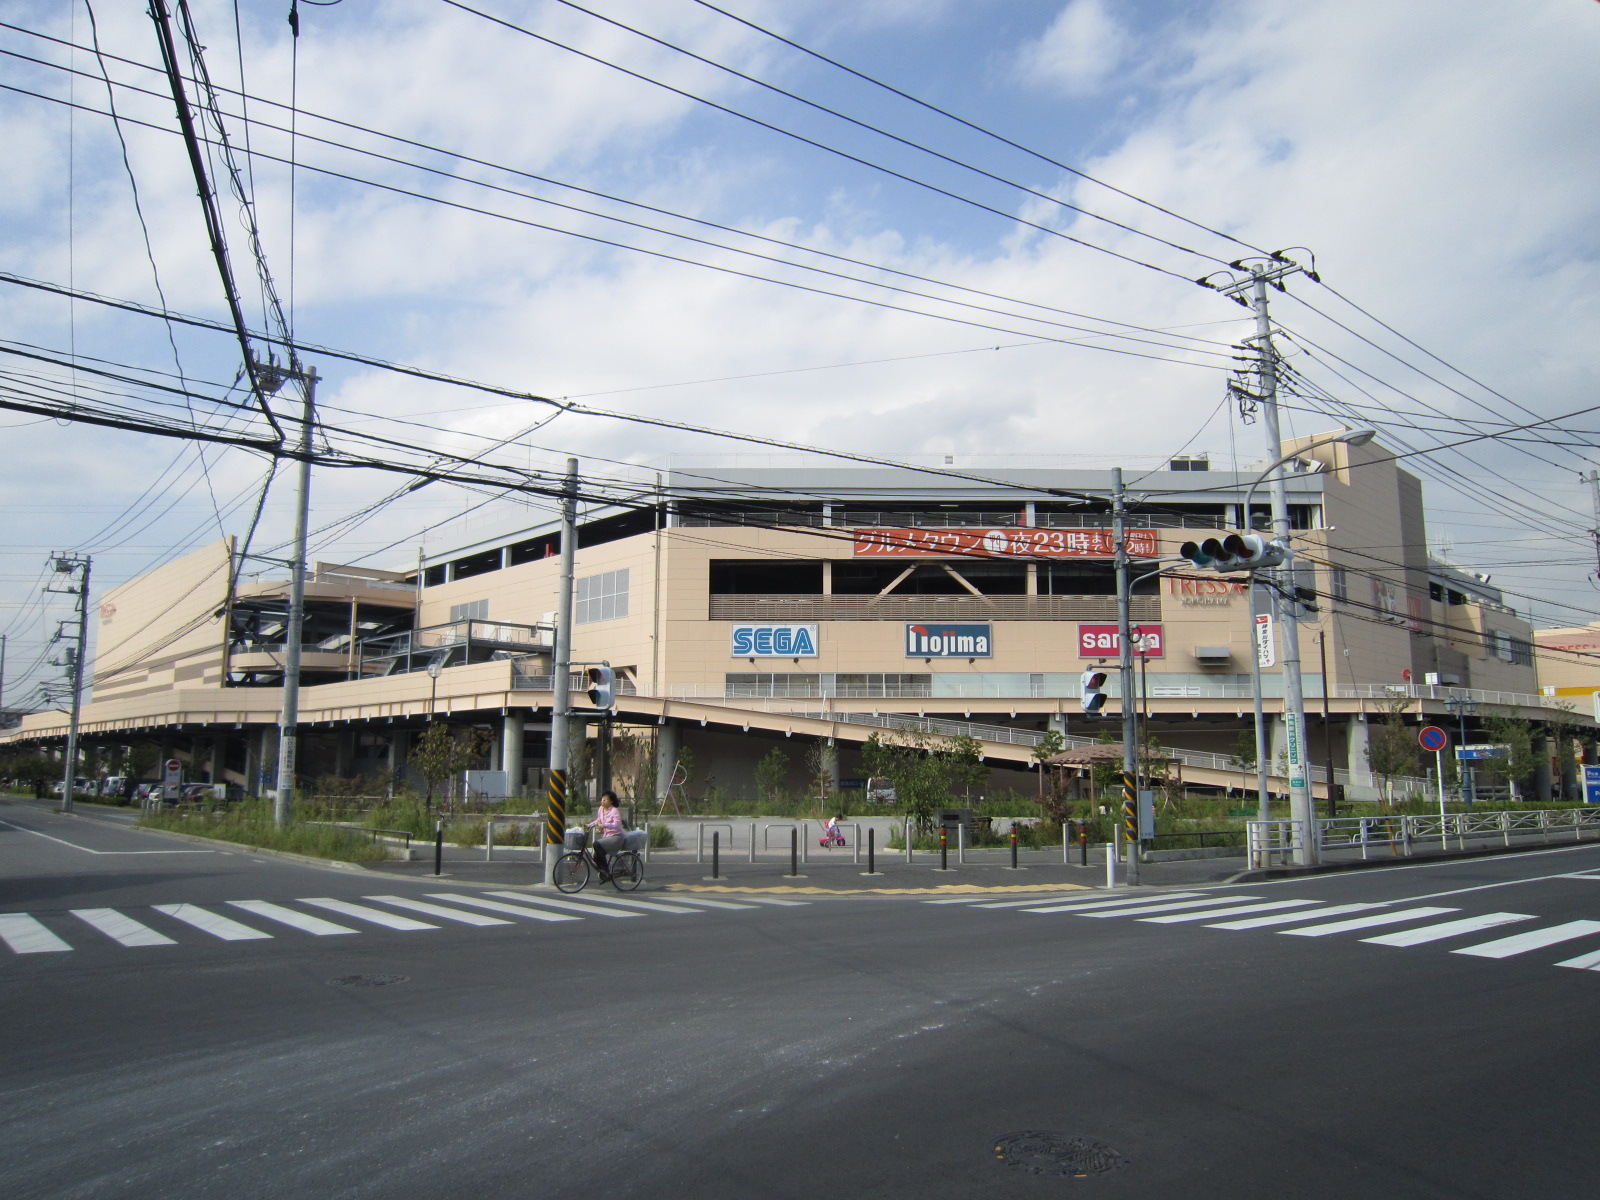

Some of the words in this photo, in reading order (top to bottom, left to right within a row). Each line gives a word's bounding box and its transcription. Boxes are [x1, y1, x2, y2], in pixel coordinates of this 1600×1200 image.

[855, 531, 981, 553] グルメタウン
[1167, 576, 1246, 594] TRESSA
[733, 627, 815, 654] SEGA
[909, 625, 988, 656] nojima
